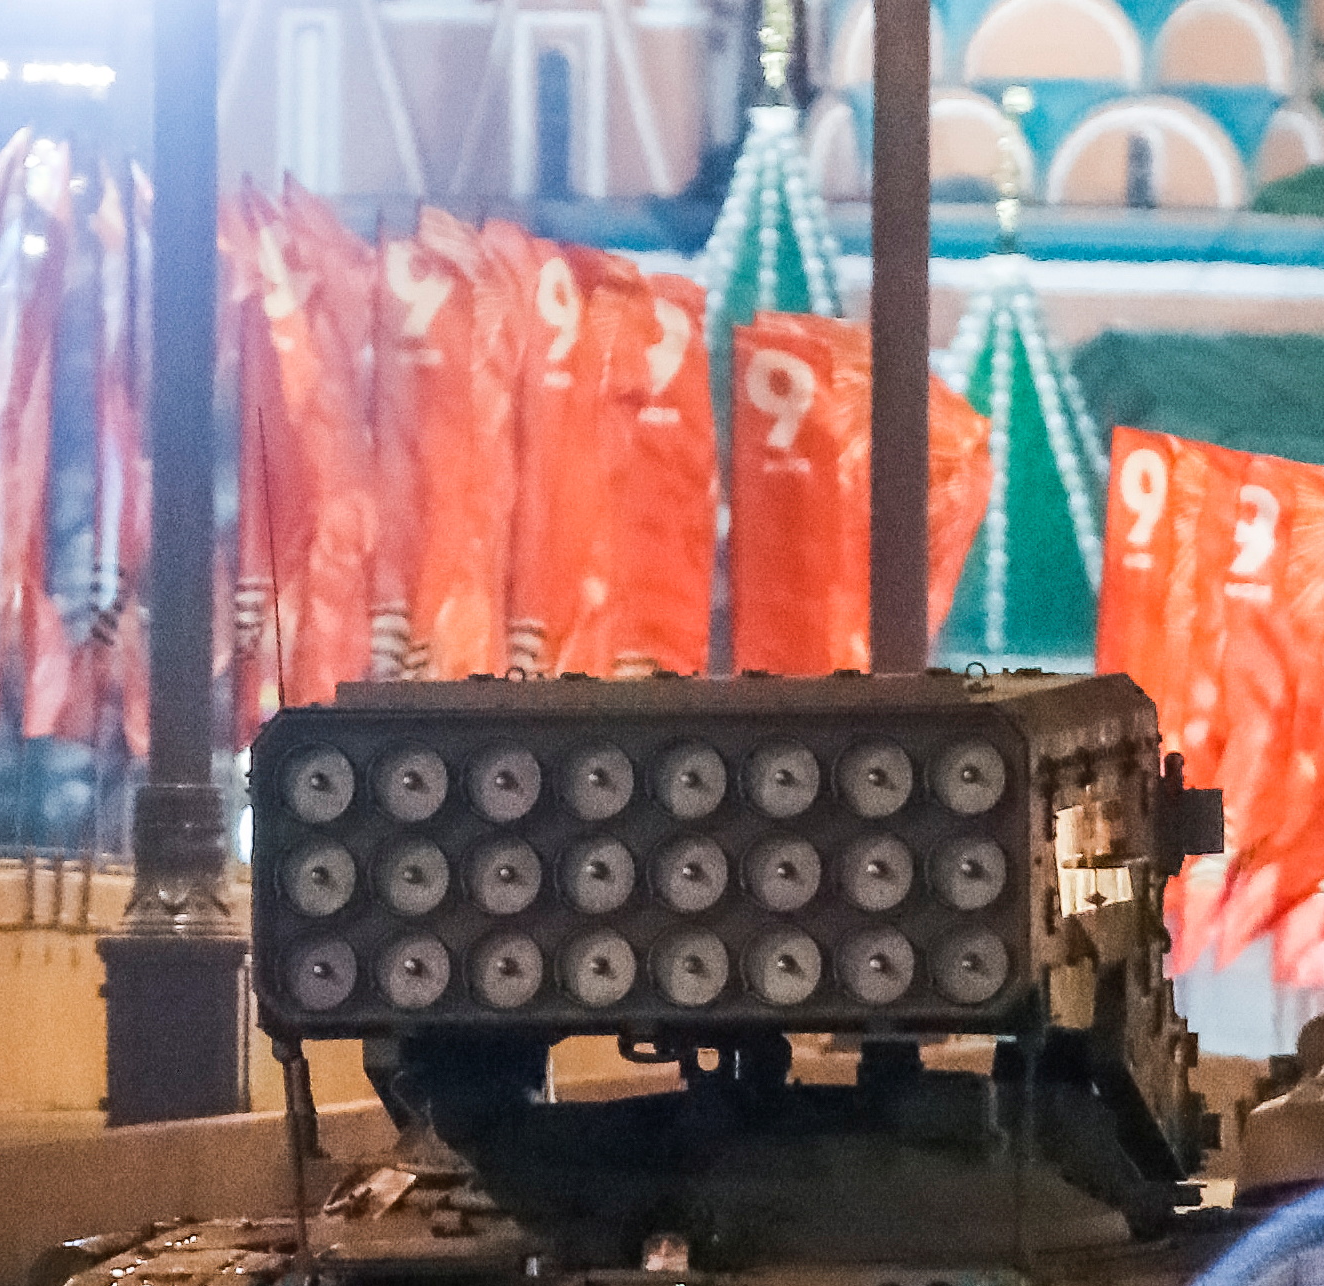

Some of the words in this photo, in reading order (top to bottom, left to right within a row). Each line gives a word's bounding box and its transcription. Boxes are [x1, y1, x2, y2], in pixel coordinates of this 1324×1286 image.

[537, 256, 580, 363] 9
[745, 348, 815, 449] 9
[1120, 448, 1168, 544] 9
